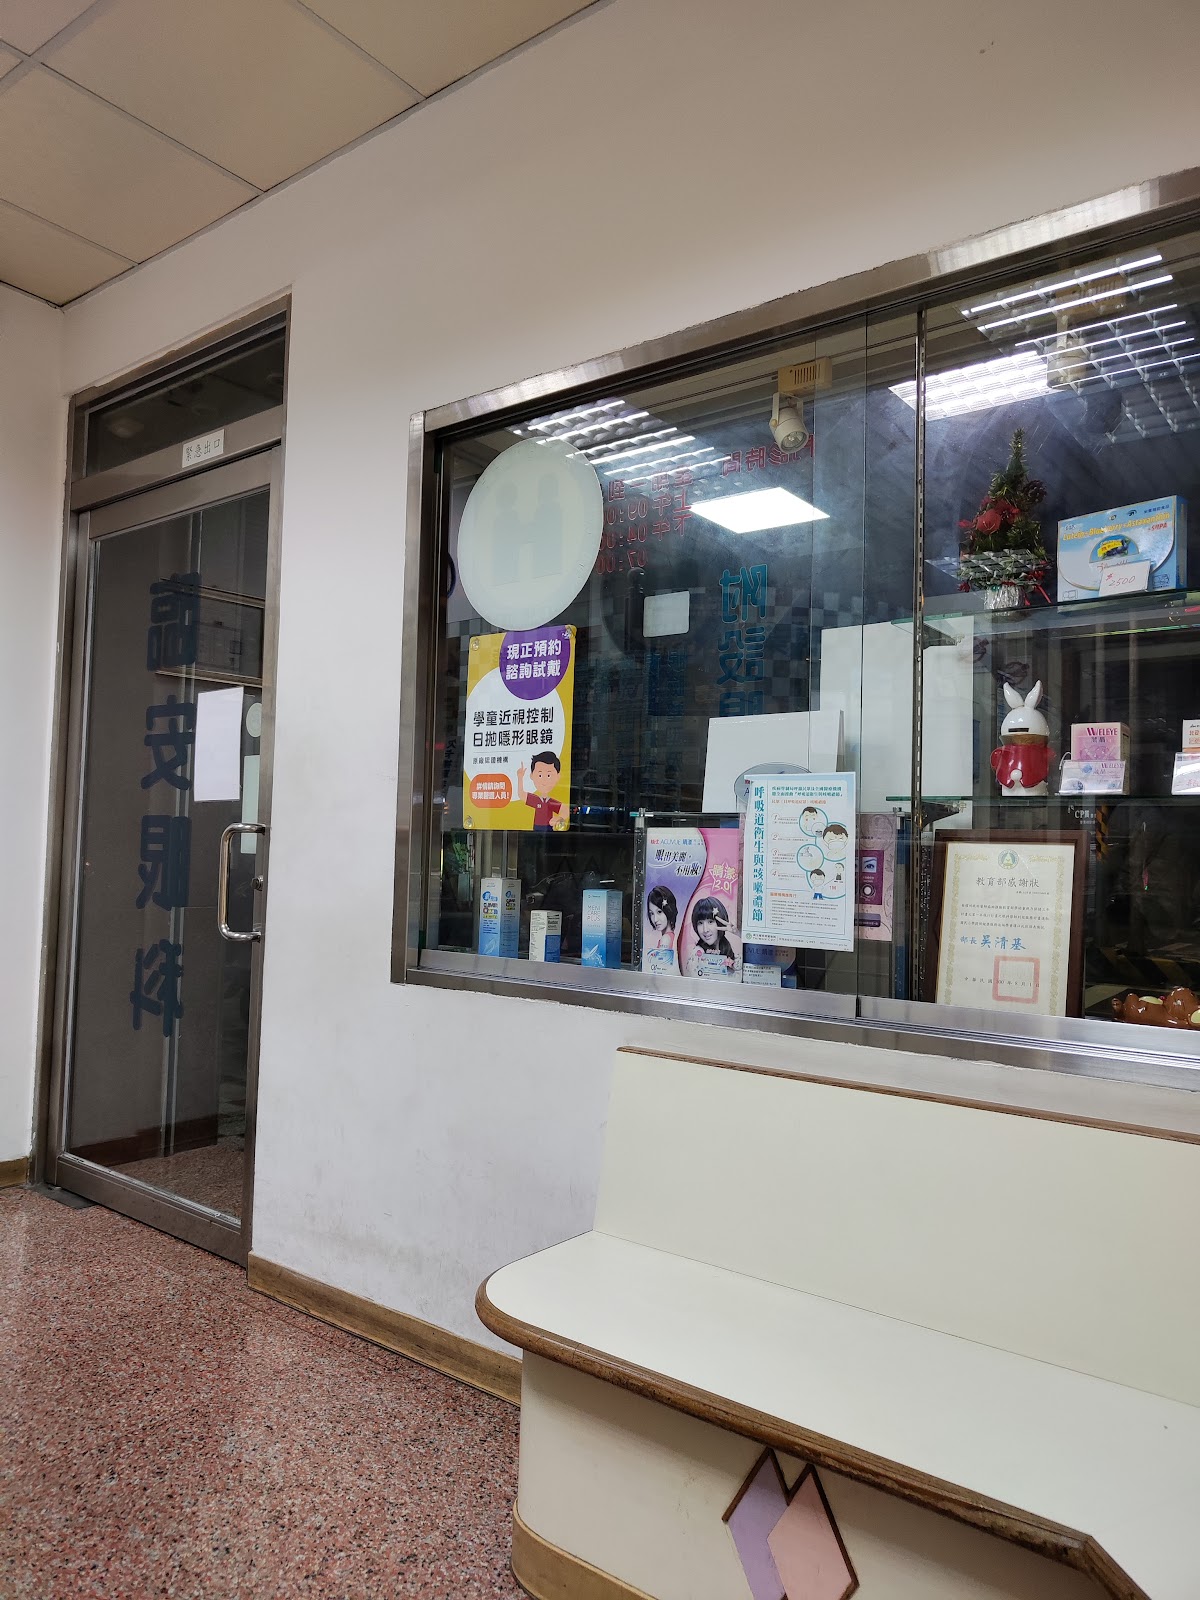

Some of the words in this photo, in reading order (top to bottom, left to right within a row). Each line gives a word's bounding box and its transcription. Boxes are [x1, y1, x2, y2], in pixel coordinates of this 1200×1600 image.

[185, 438, 221, 462] 緊急出口
[507, 639, 562, 660] 現正預約
[505, 659, 562, 680] 諮詢試戴
[473, 706, 554, 727] 學童近視控制
[473, 728, 554, 748] 日拋隱形眼鏡
[1086, 727, 1118, 736] WELEYE
[752, 786, 764, 921] 呼吸道衛生與咳嗽禮節
[714, 879, 730, 891] 2.0
[976, 876, 1040, 888] 教育部感謝狀
[960, 935, 978, 944] 部長
[980, 934, 1027, 951] 吳清基
